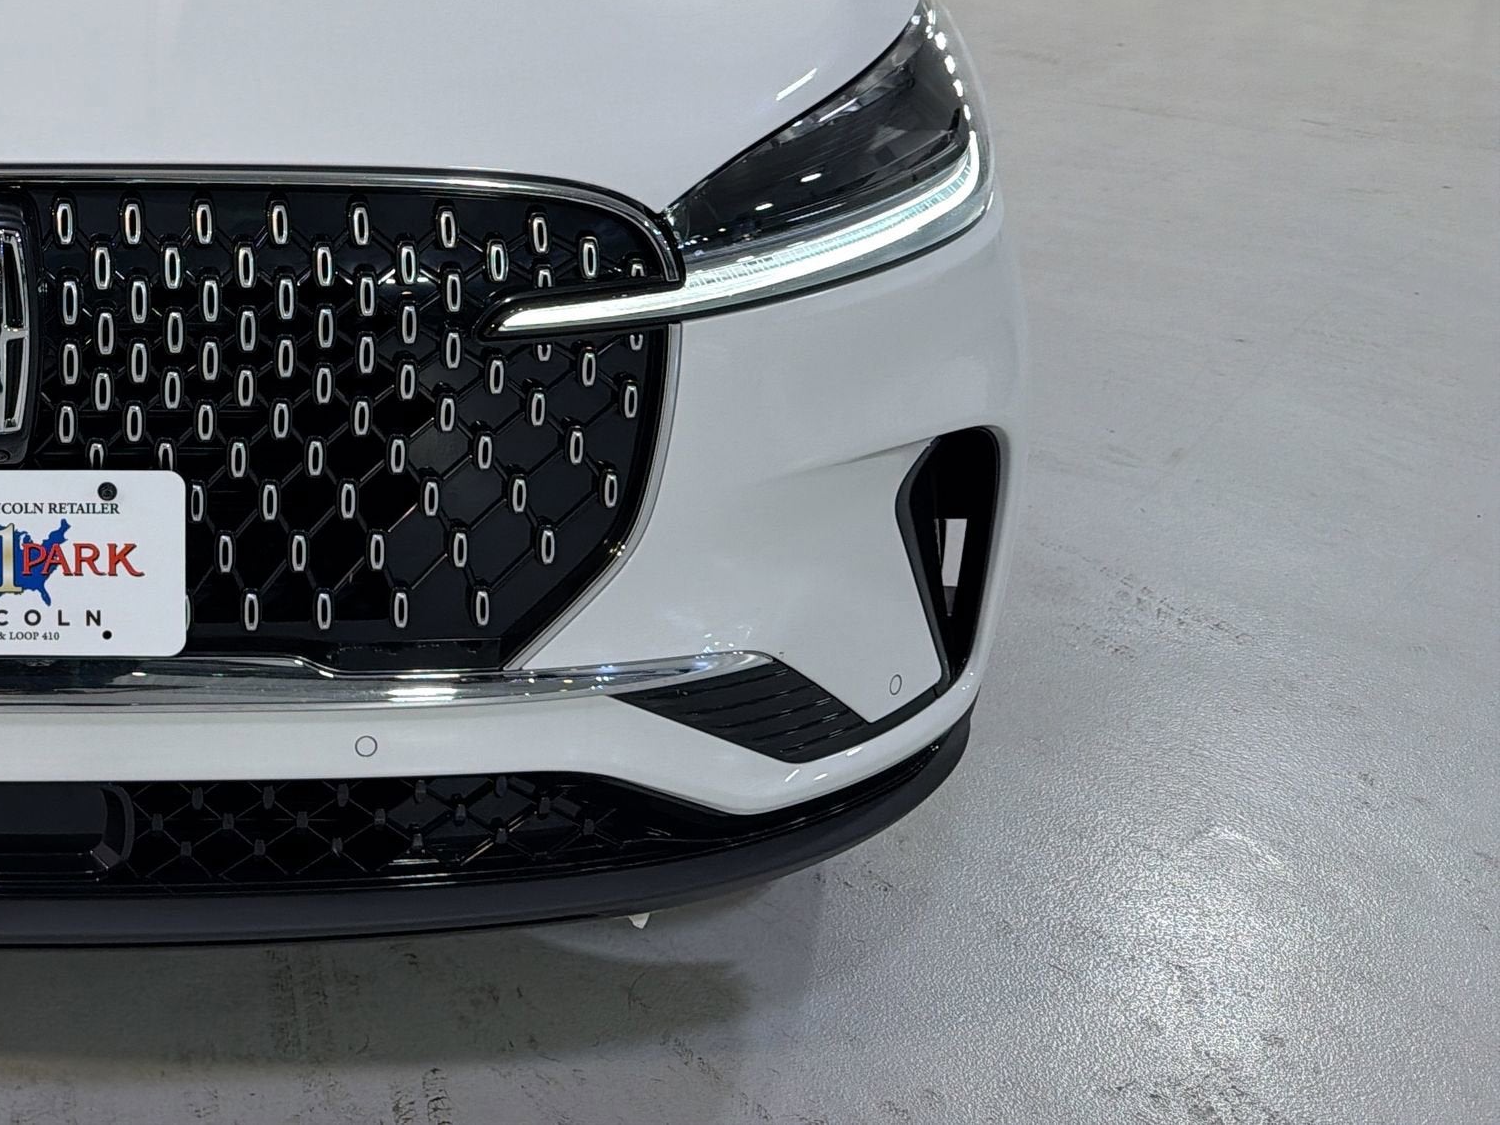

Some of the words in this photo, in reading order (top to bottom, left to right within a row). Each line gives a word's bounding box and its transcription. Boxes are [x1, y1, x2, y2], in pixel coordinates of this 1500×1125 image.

[48, 502, 121, 515] RETAILER
[20, 541, 146, 578] PARK
[9, 631, 40, 641] LOOP
[41, 631, 60, 641] 410
